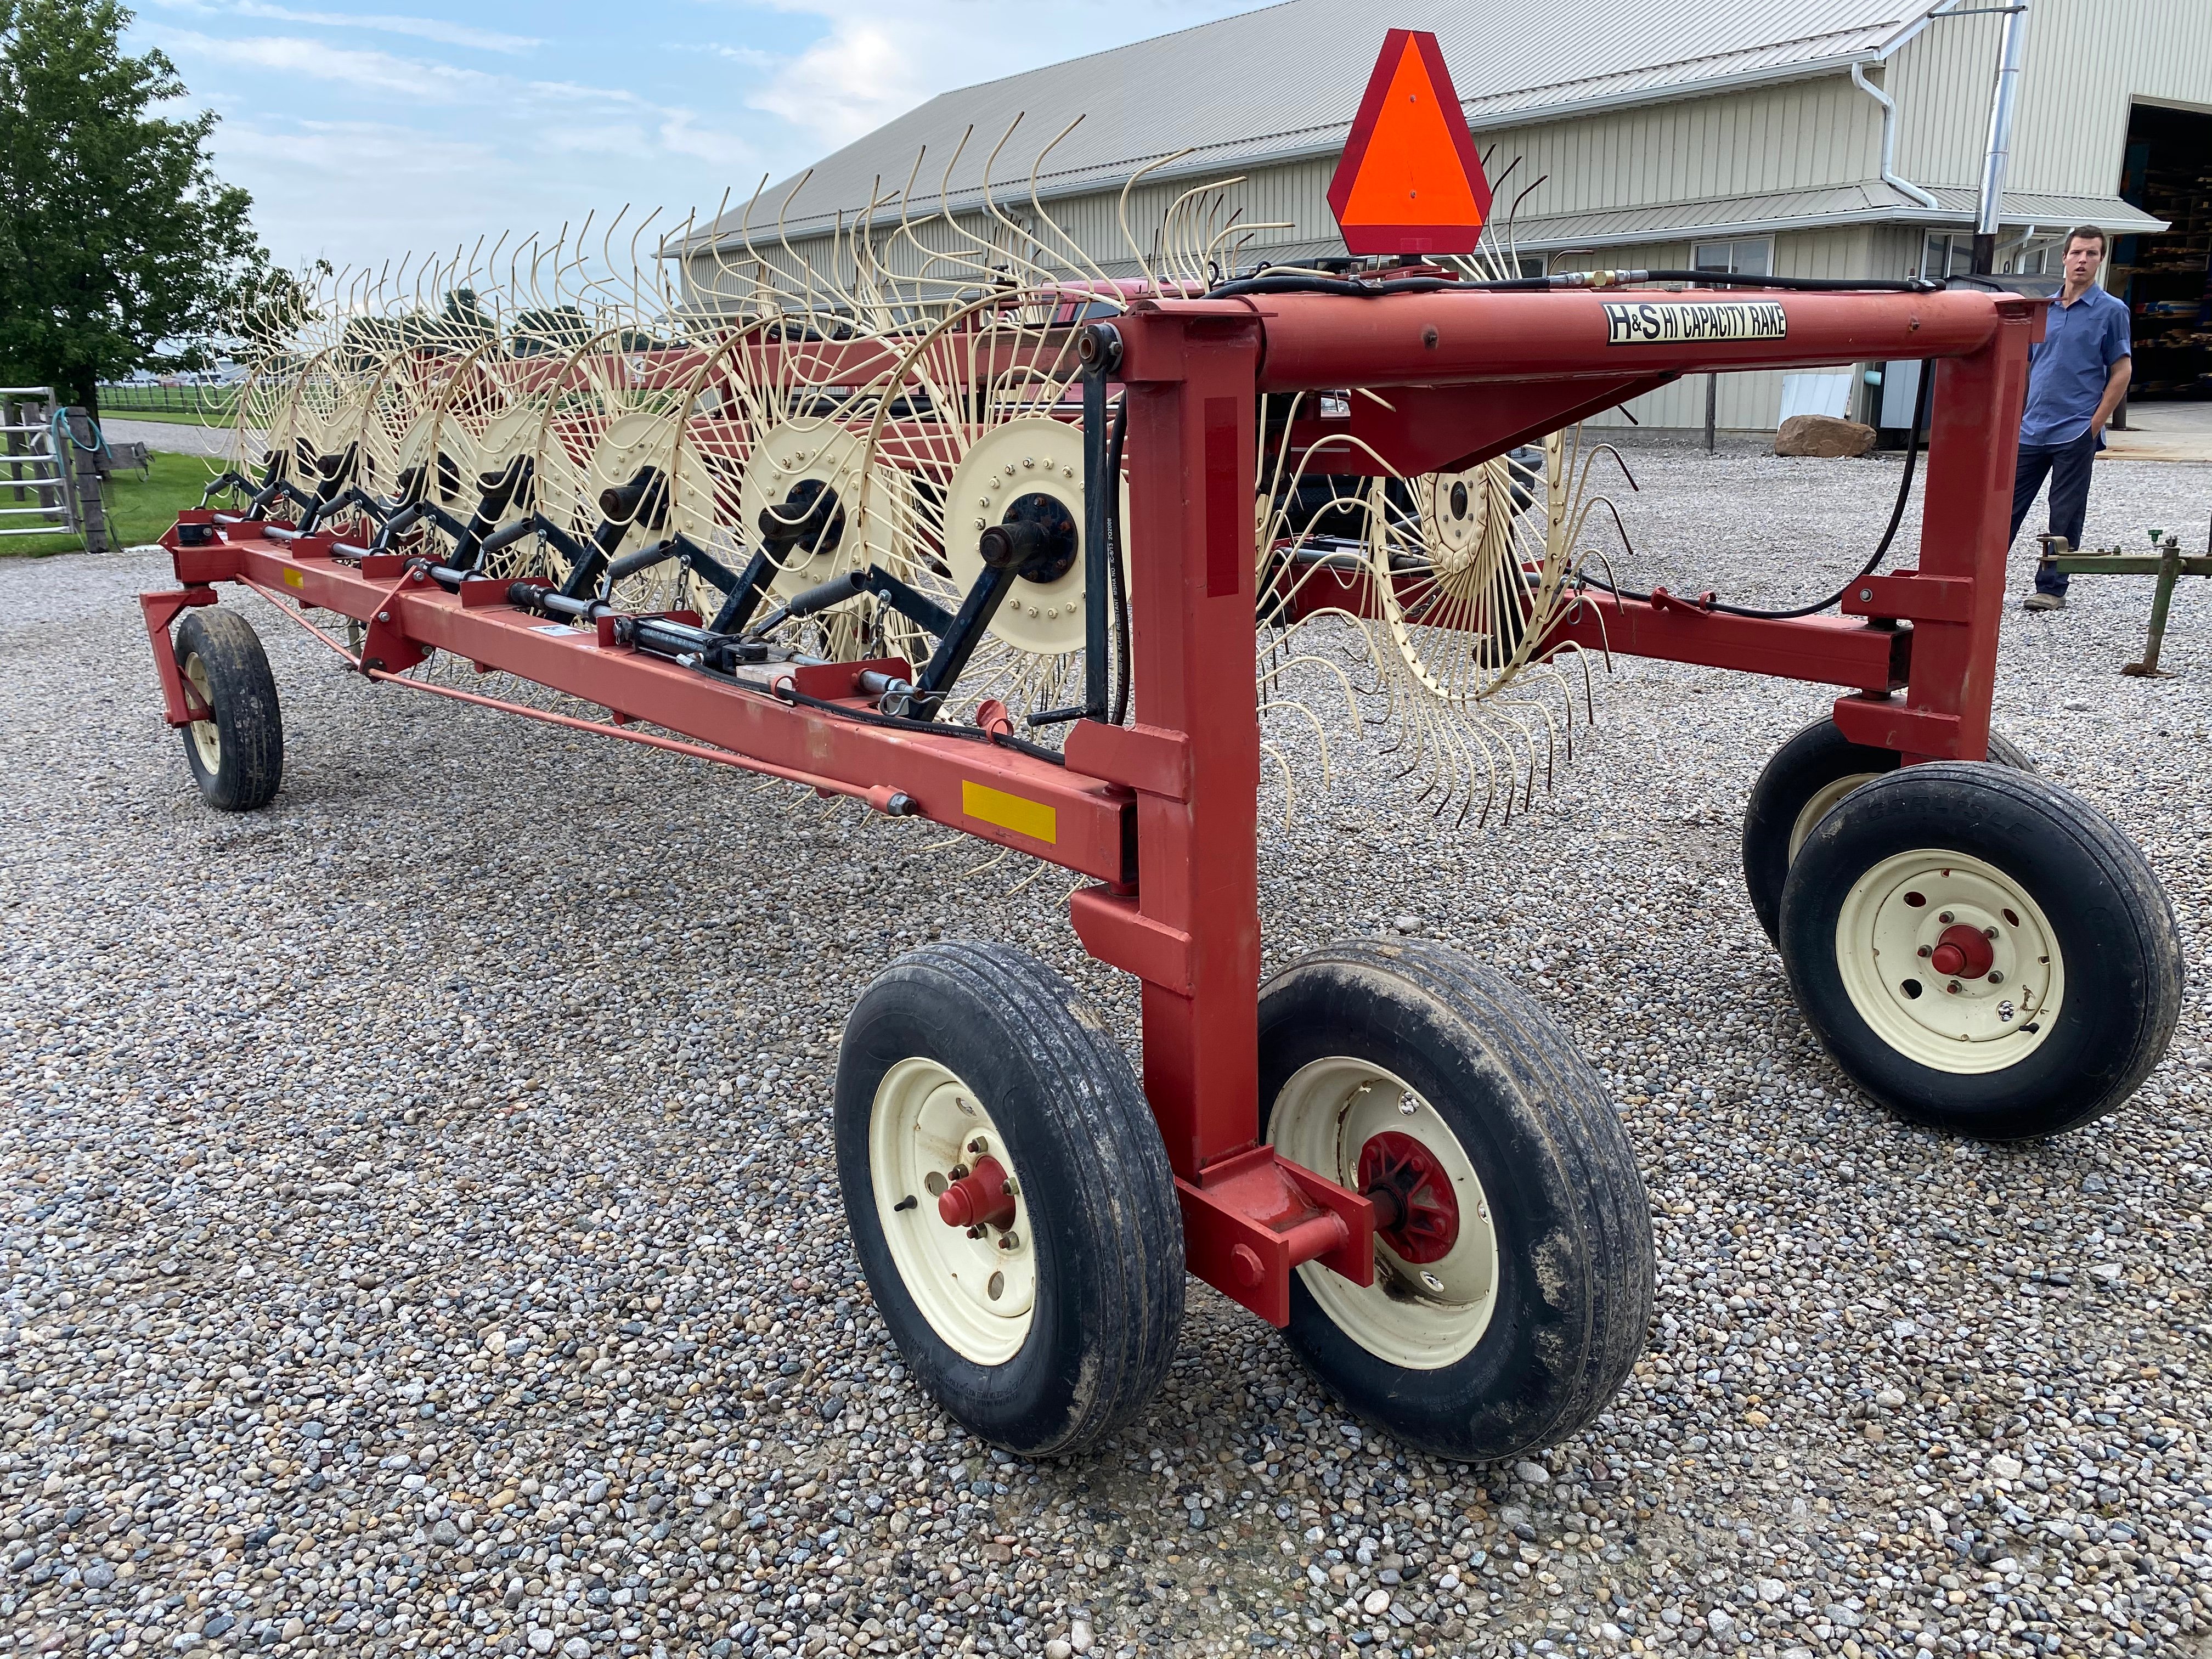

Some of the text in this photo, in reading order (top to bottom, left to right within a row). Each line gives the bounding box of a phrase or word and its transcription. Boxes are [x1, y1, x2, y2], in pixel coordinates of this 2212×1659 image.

[1607, 304, 1786, 340] H&S HI CAPACITY RAKE
